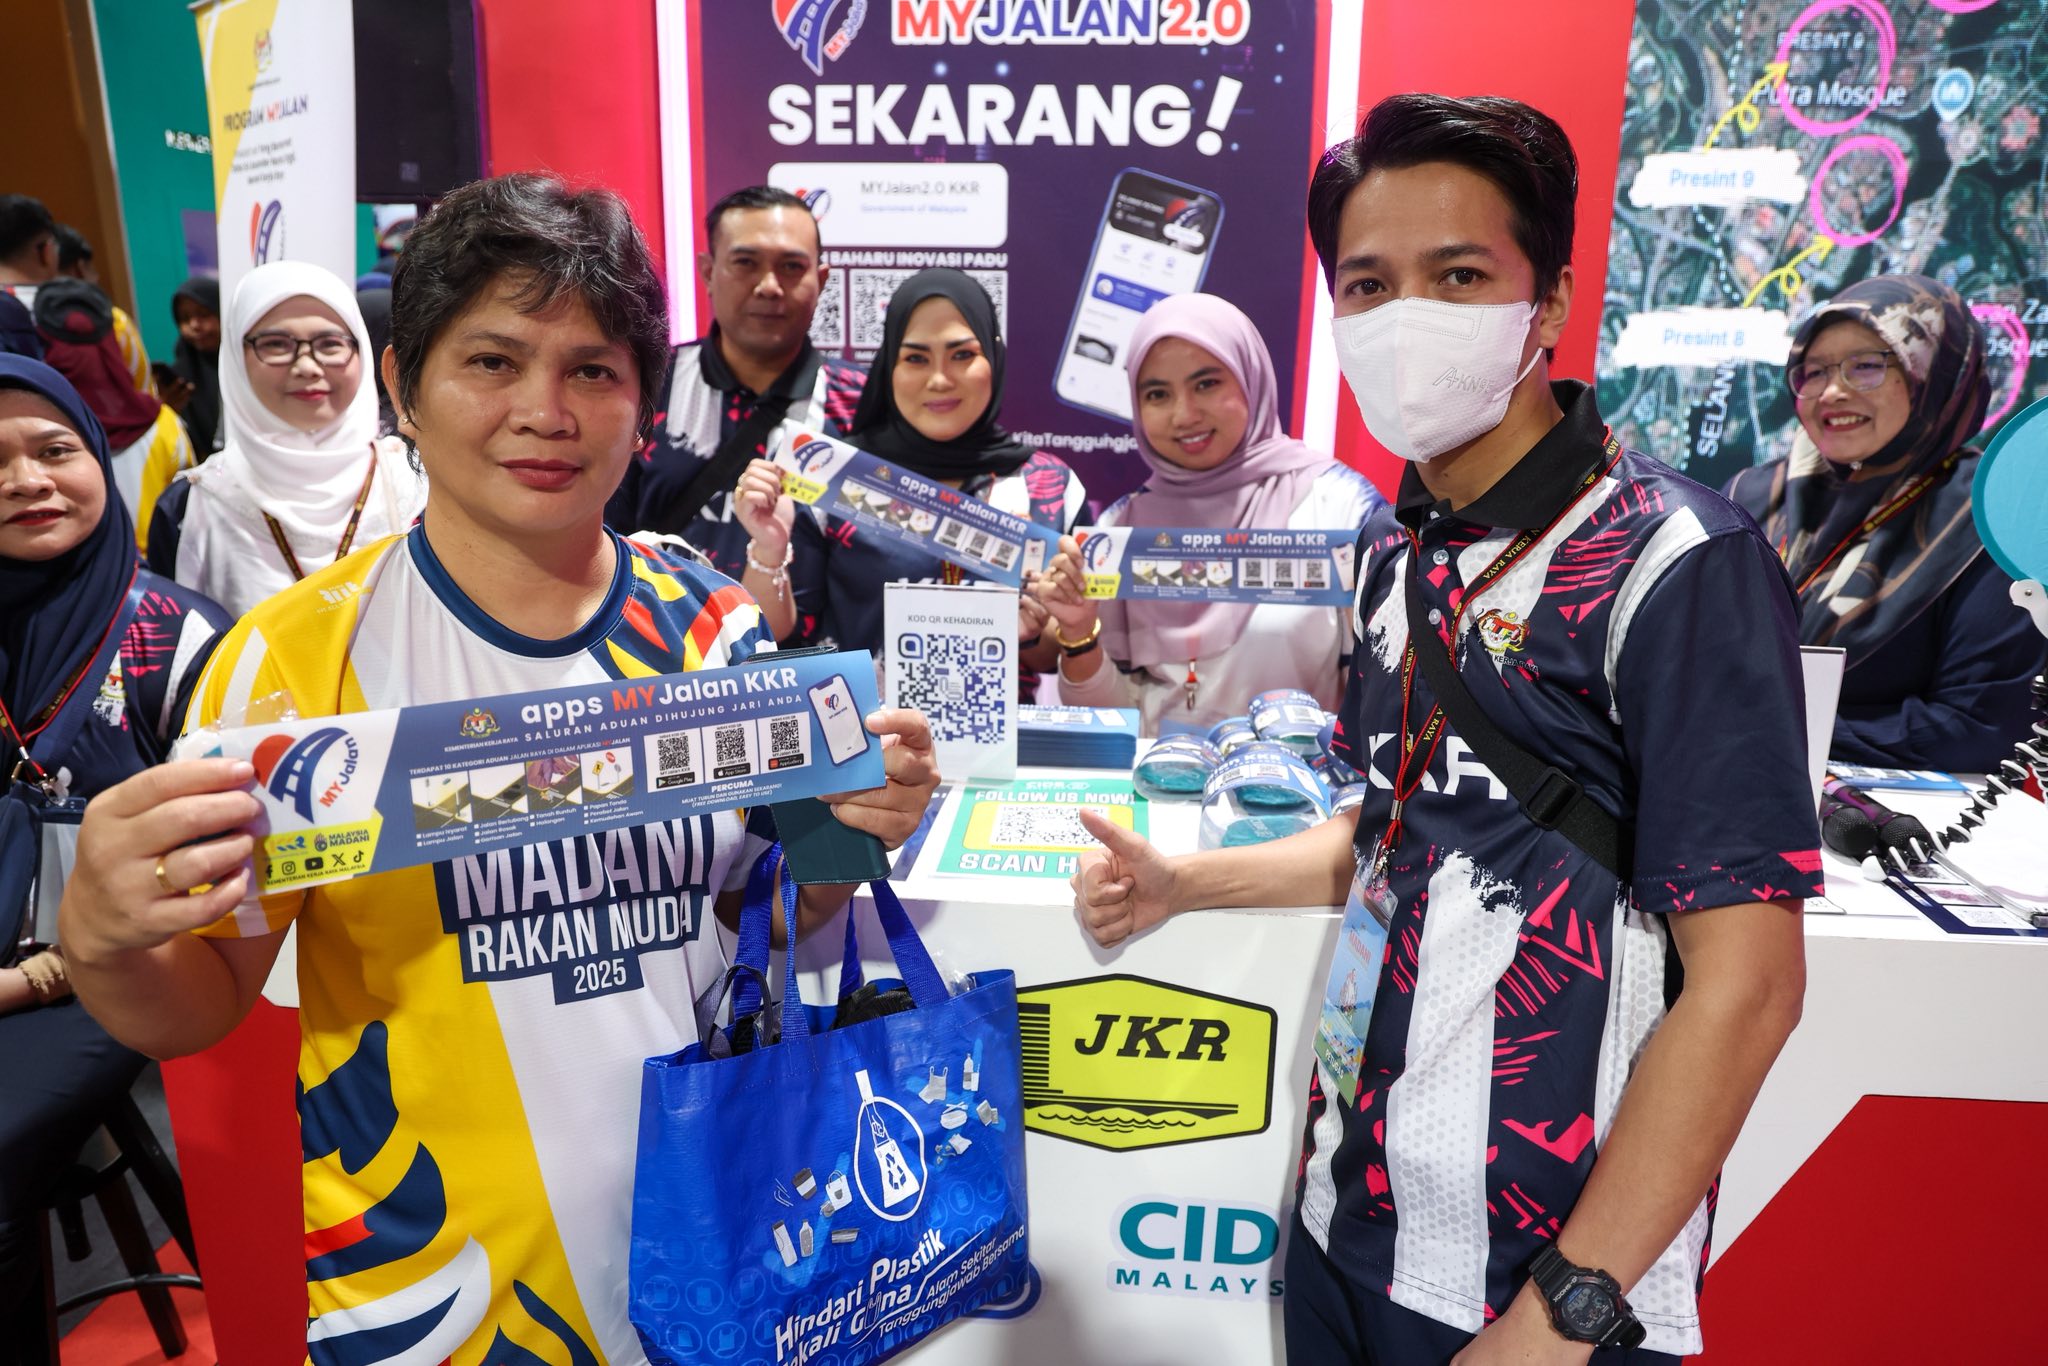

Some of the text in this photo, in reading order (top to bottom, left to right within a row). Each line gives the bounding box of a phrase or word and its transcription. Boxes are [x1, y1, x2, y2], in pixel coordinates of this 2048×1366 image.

[896, 0, 1245, 40] MYJALAN 2.0
[768, 75, 1243, 156] SEKARANG!
[949, 181, 980, 194] KKR
[1670, 168, 1755, 188] Presint 9
[830, 250, 895, 266] BAHARU
[896, 251, 962, 267] INOVASI
[963, 252, 1008, 268] PADU
[1663, 327, 1745, 347] Presint 8
[900, 475, 937, 498] apps
[999, 513, 1027, 535] KKR
[1181, 533, 1221, 548] apps
[1295, 533, 1327, 546] KKR
[1482, 535, 1532, 579] KERJA RAYA
[907, 614, 994, 626] KOD QR KEHADIRAN
[521, 696, 603, 729] apps
[743, 667, 799, 694] KKR
[525, 694, 802, 742] SALURAN ADUAN DIHUJUNG JARI ANDA
[1423, 718, 1440, 742] RAYA
[444, 742, 484, 752] KEMENTERIAN
[484, 739, 502, 747] KERJA
[409, 766, 443, 775] TERDAPAT
[452, 760, 485, 768] KATEGORI
[486, 756, 509, 764] ADUAN
[555, 746, 575, 754] DALAM
[319, 736, 359, 808] MYJalan
[711, 779, 753, 793] PERCUMA
[727, 788, 753, 797] GUNAKAN
[975, 790, 1136, 805] FOLLOW US NOW!
[480, 820, 497, 828] Jalan
[536, 811, 555, 819] Tanah
[536, 817, 565, 826] Halangan
[590, 814, 624, 823] Kemudahan
[328, 829, 368, 840] MALAYSIA
[423, 830, 444, 839] Lampu
[498, 825, 516, 833] Rosak
[505, 831, 522, 839] Jalan
[329, 835, 370, 847] MADANI
[424, 834, 463, 846] Lampu Jalan
[452, 820, 705, 920] MADANI
[959, 852, 1047, 873] SCAN
[266, 874, 306, 885] KEMENTERIAN
[339, 864, 365, 872] MALAYSIA
[468, 906, 598, 974] RAKAN
[573, 957, 628, 995] 2025
[1074, 1013, 1231, 1062] JKR
[1325, 1048, 1344, 1080] PETUGAS
[1119, 1201, 1281, 1266] CID
[926, 1236, 998, 1301] Alam Sekitar
[878, 1223, 1025, 1338] Tanggungjawab Bersama
[1115, 1268, 1285, 1297] MALAYS
[1552, 1275, 1578, 1303] G-SHOCK
[774, 1227, 947, 1363] Hindari Plastik
[782, 1320, 842, 1366] kali
